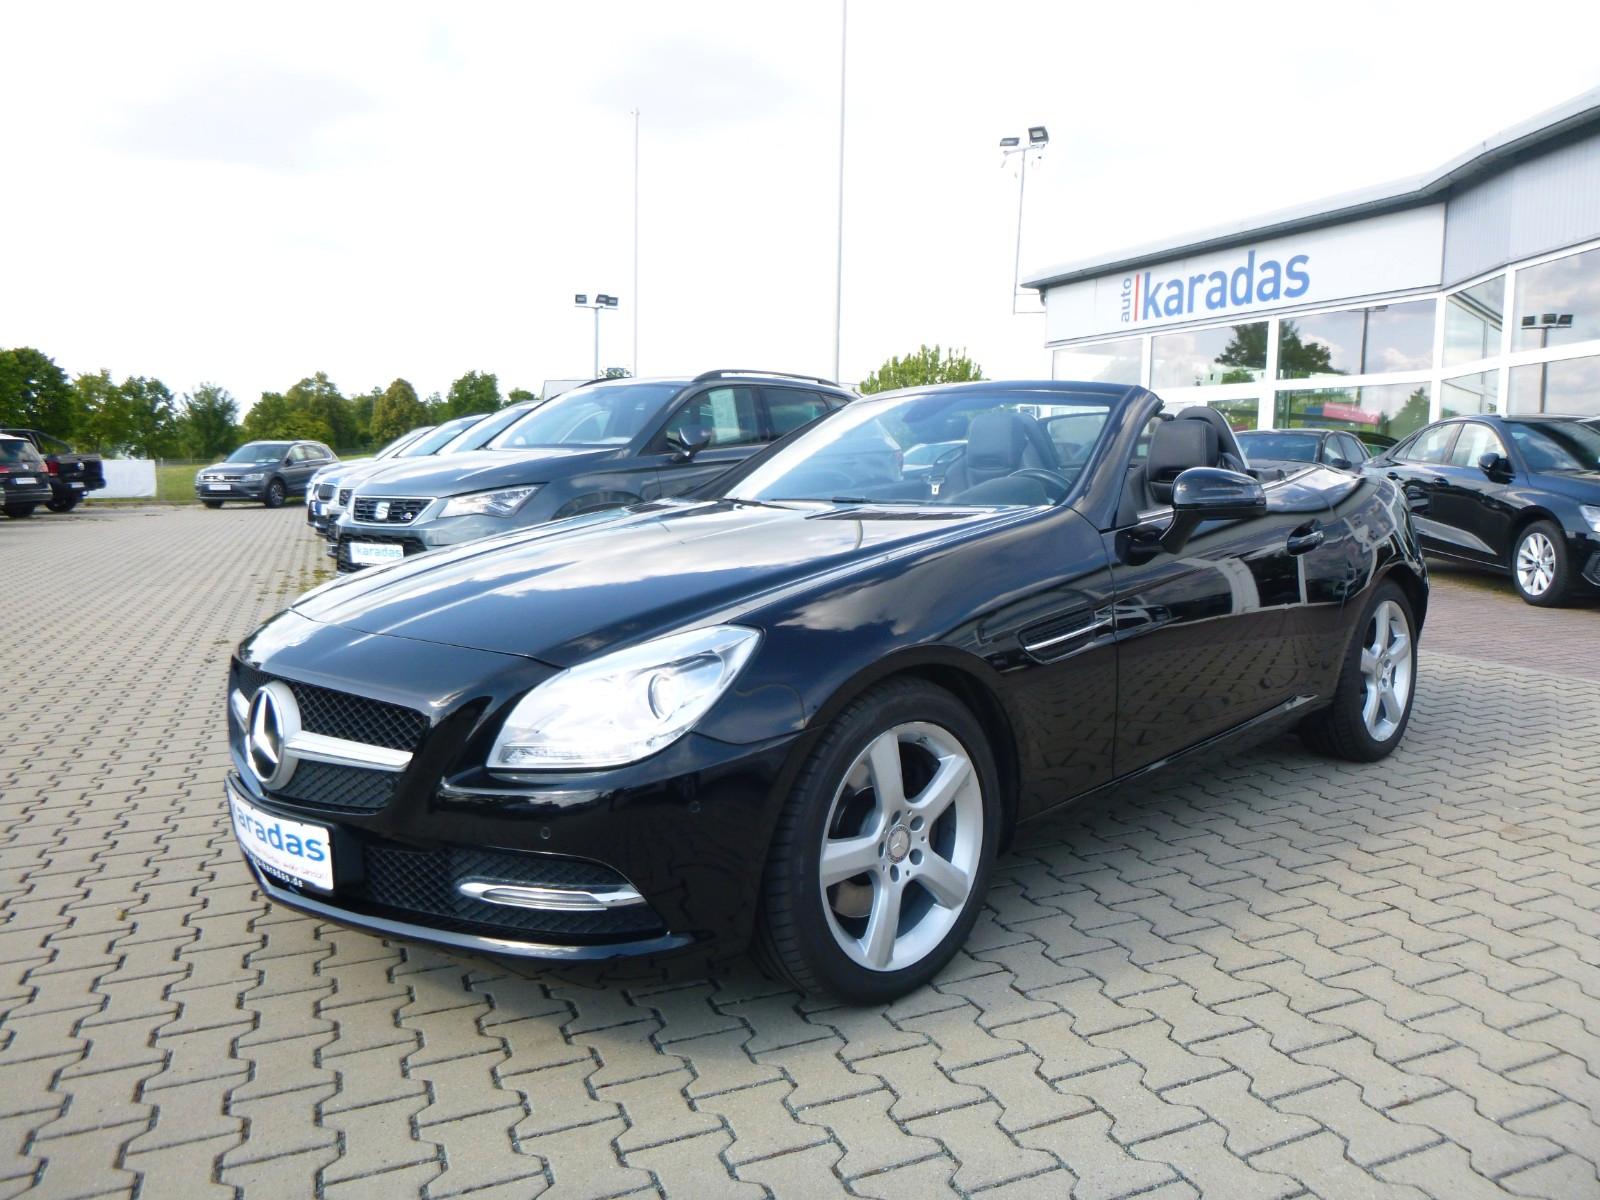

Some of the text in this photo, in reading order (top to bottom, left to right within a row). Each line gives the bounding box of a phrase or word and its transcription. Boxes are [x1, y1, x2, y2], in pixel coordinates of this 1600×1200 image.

[1120, 277, 1132, 323] auto
[1142, 249, 1310, 320] karadas
[232, 802, 326, 863] aradas
